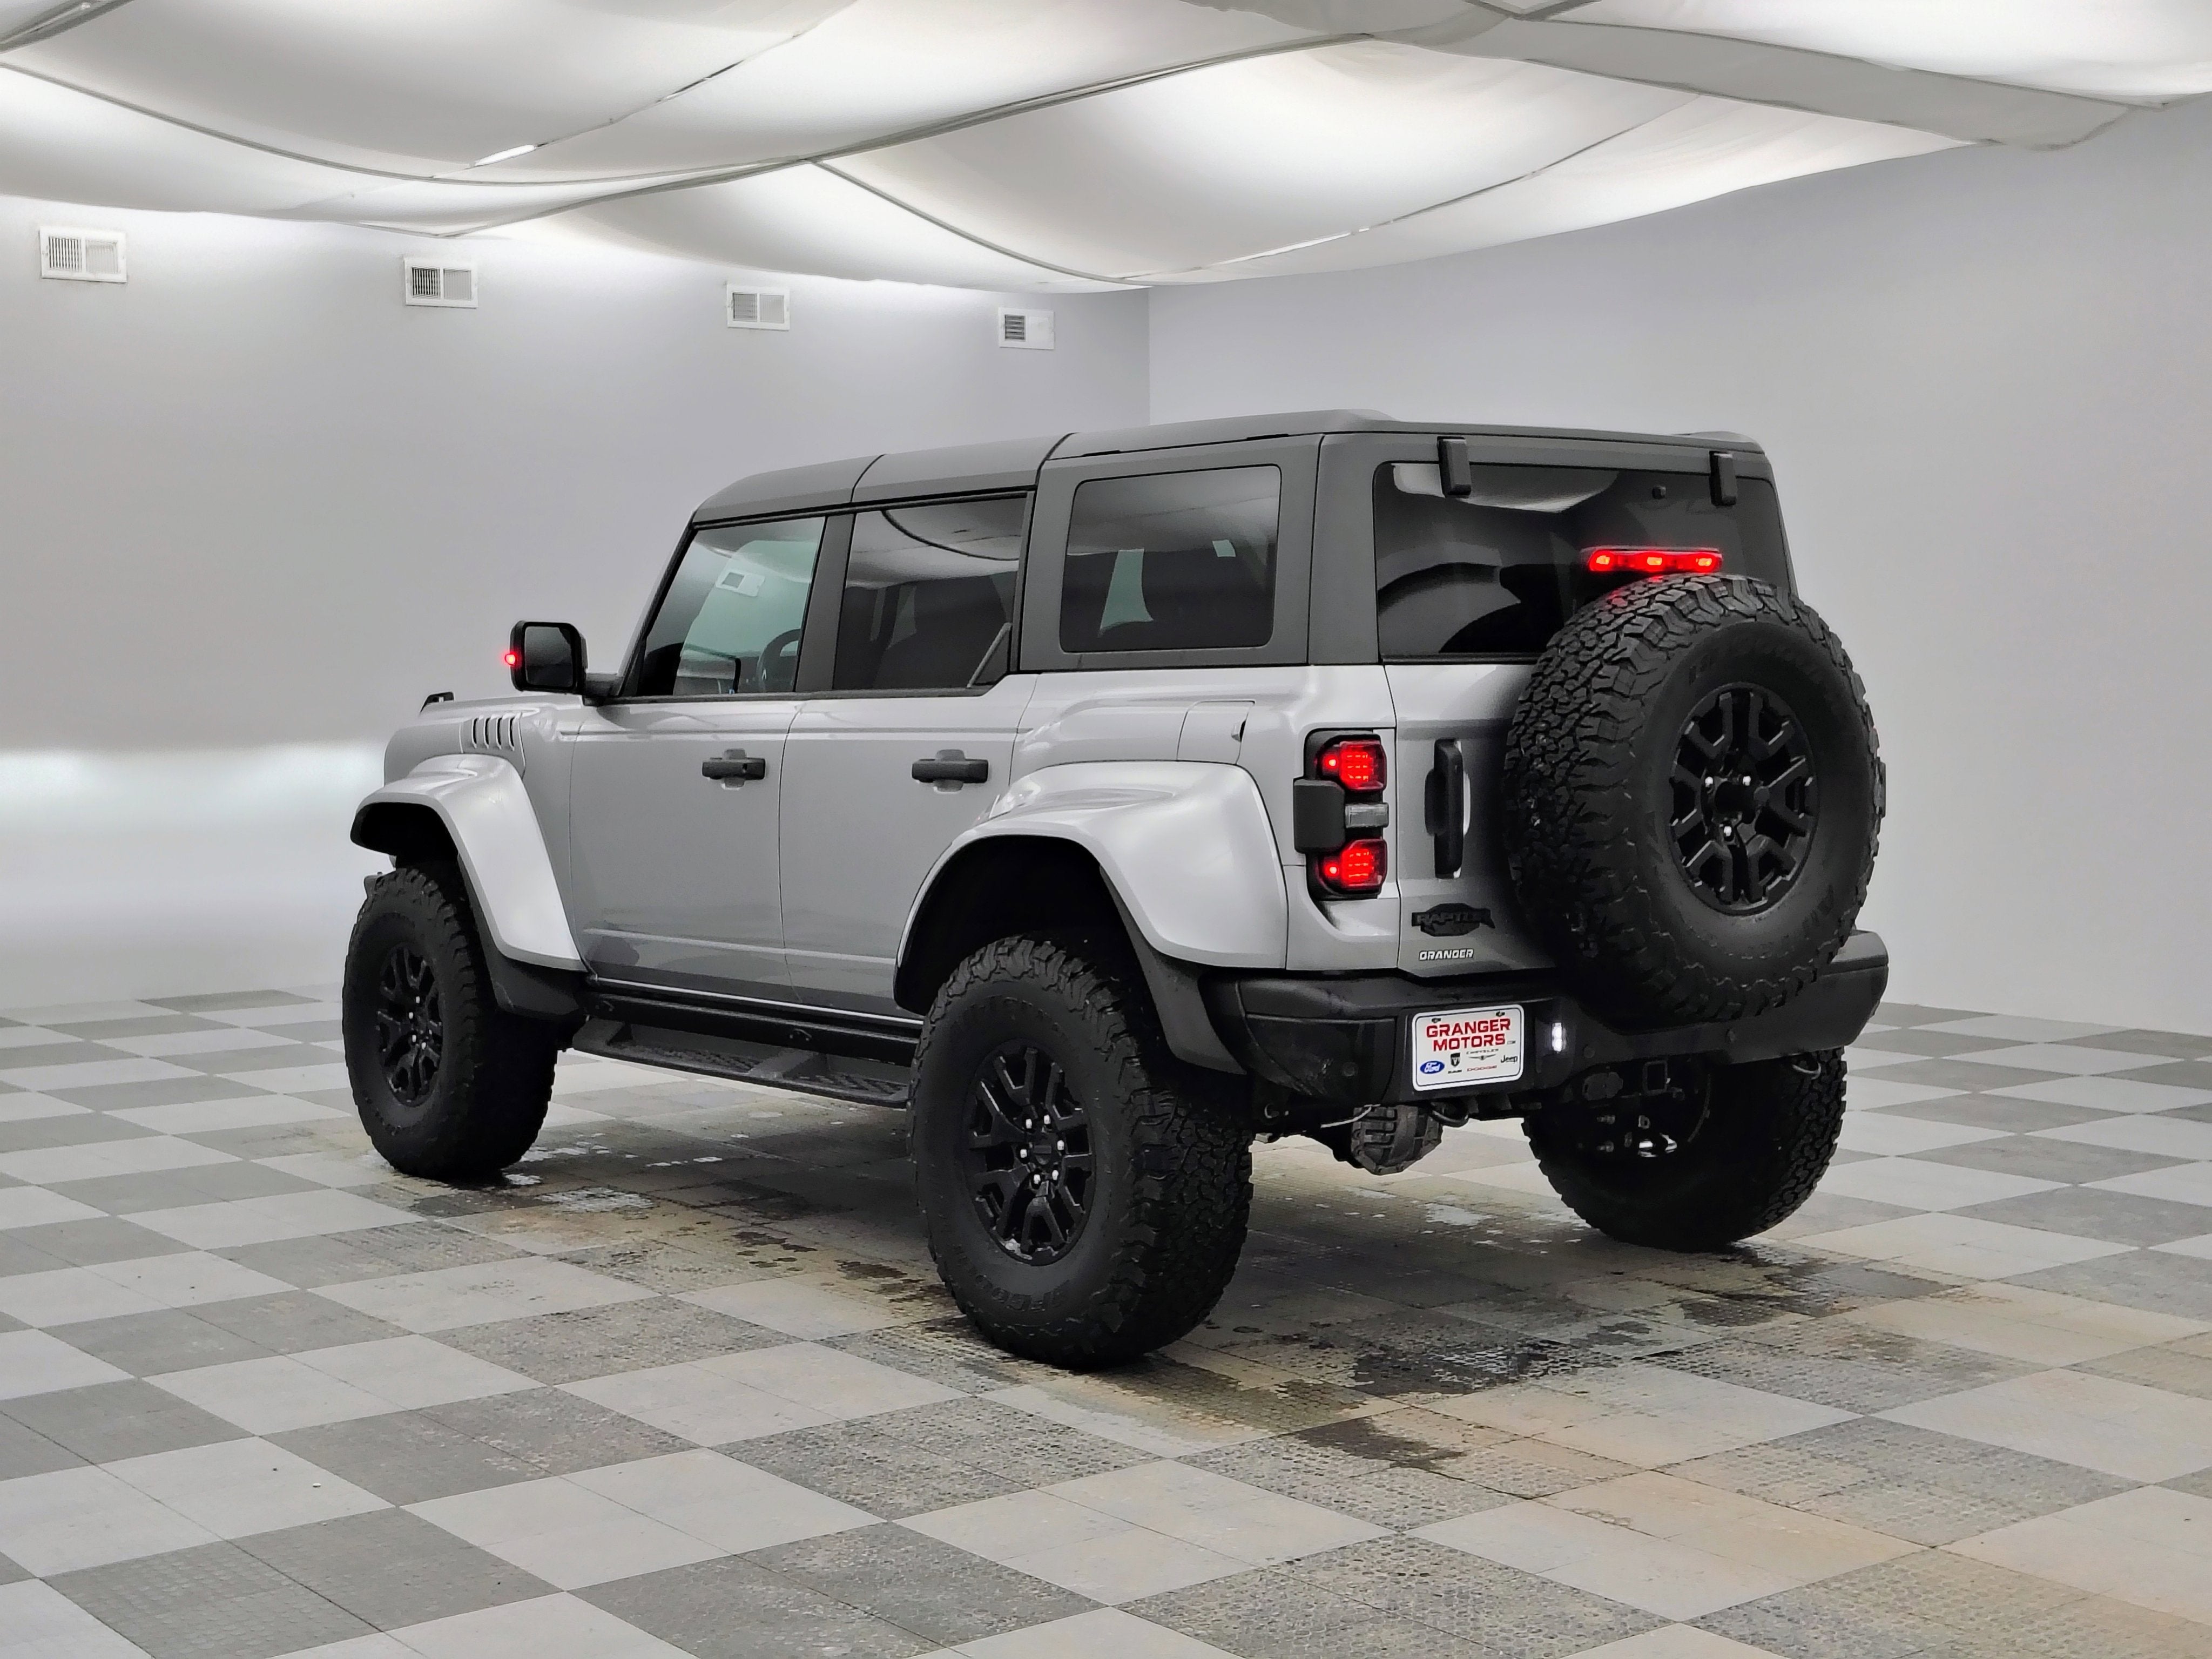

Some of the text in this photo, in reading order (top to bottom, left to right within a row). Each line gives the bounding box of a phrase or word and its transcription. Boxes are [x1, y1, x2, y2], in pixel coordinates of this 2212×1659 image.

[1419, 948, 1474, 961] GRANGER
[1426, 1018, 1510, 1037] GRANGER
[1433, 1034, 1505, 1051] MOTORS
[1500, 1055, 1518, 1063] Jeep
[1424, 1062, 1441, 1074] Ford
